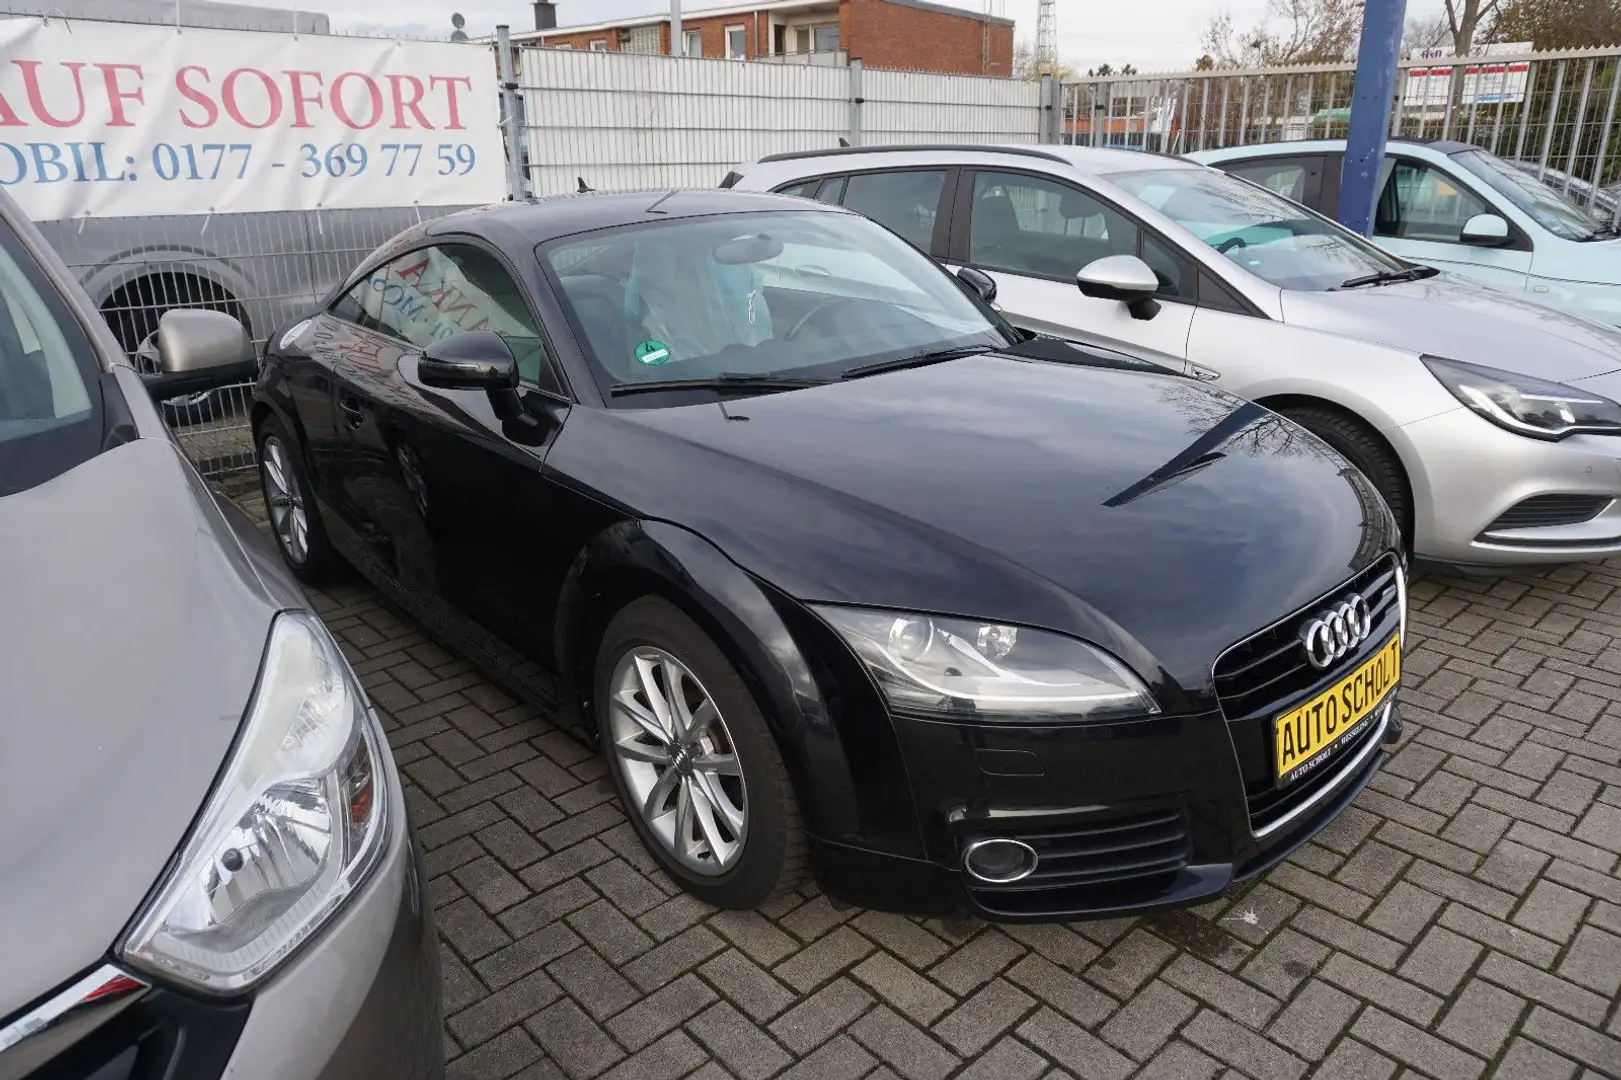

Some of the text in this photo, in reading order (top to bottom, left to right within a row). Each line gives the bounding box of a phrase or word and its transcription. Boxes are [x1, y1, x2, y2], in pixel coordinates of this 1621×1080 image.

[174, 64, 473, 131] SOFORT
[0, 141, 138, 185] OBIL:
[152, 142, 253, 181] 0177
[300, 141, 369, 180] 369
[380, 142, 423, 177] 77
[437, 141, 477, 177] 59
[1282, 640, 1398, 767] AUTO SCHOLT
[1290, 763, 1309, 782] AUTO
[1308, 747, 1332, 770] SCHOLT
